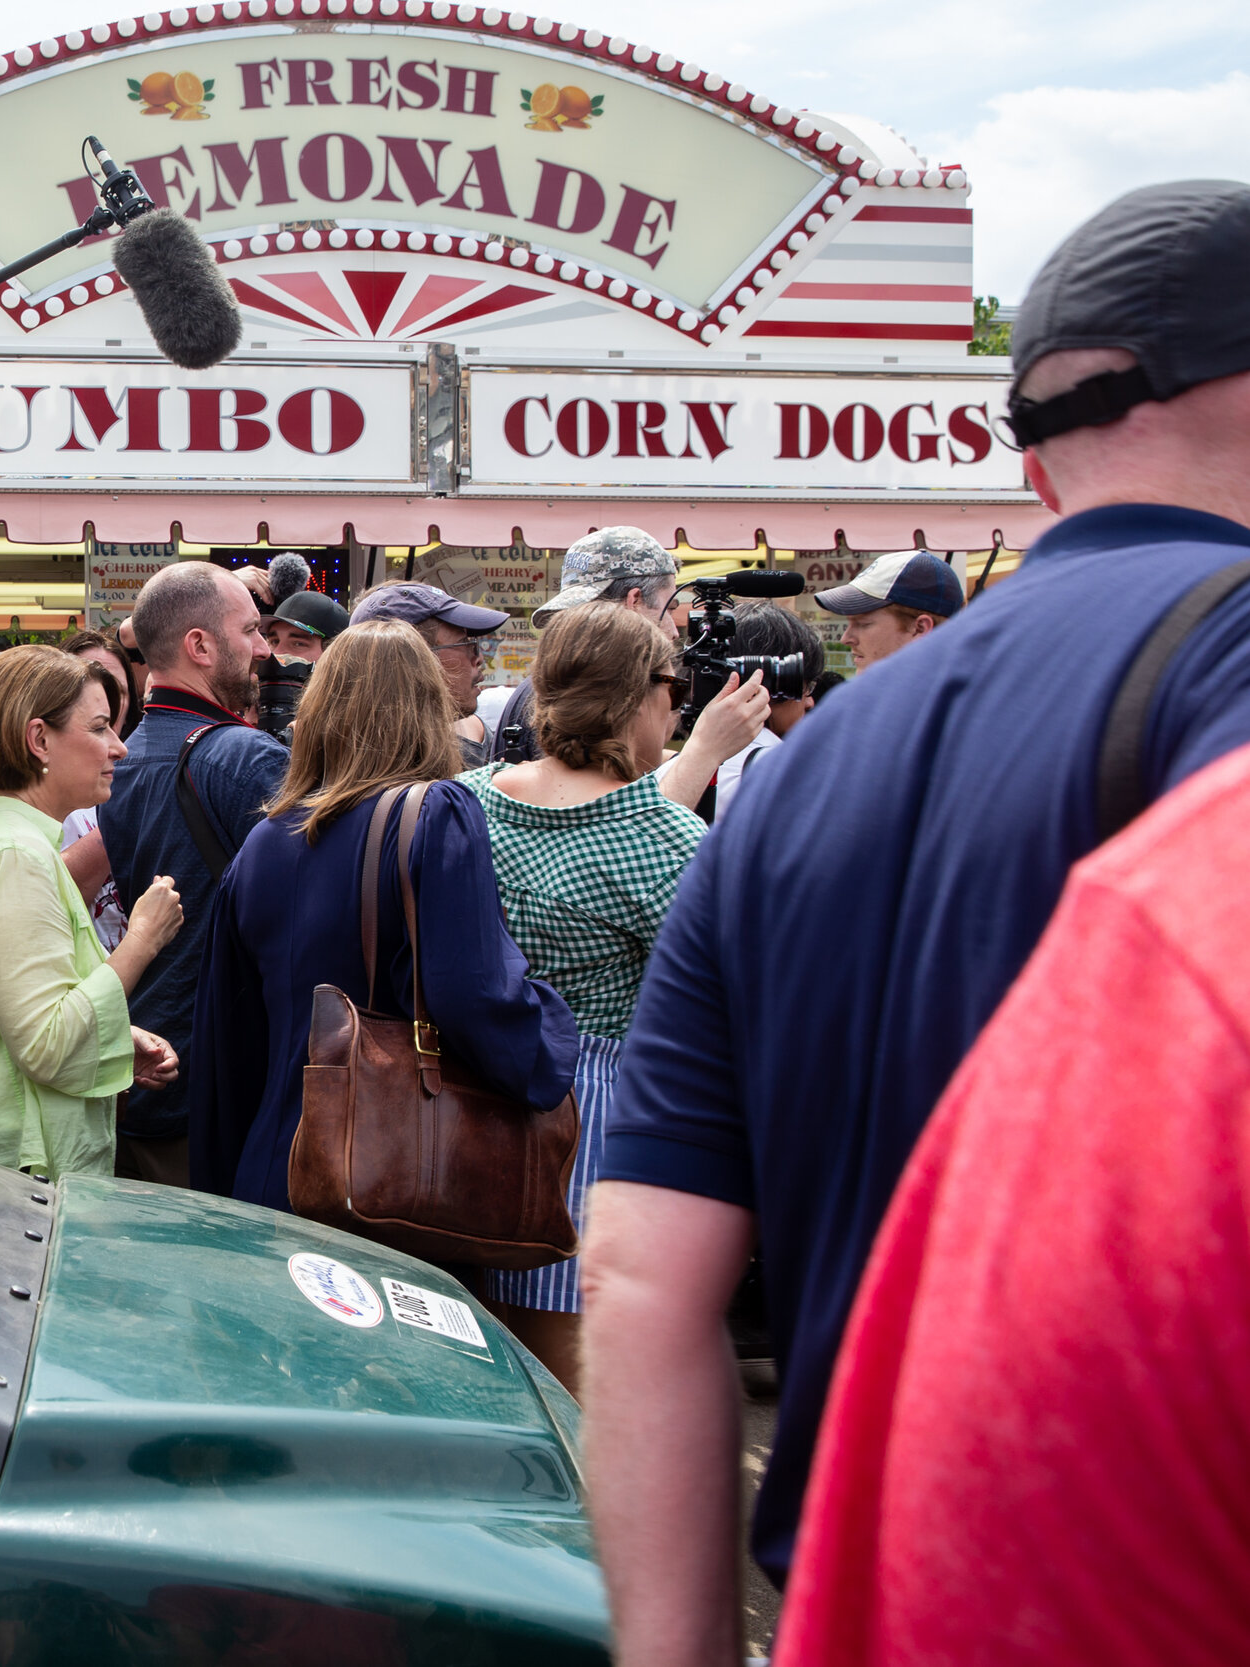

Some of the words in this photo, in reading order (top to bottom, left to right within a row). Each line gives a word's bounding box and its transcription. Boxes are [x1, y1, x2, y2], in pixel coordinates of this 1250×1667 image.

[236, 57, 501, 118] FRESH
[57, 133, 677, 271] LEMONADE
[504, 394, 738, 463] CORN
[773, 401, 992, 468] DOGS
[94, 542, 118, 556] ICE
[130, 542, 175, 557] COLD
[471, 547, 489, 561] CE
[500, 547, 543, 561] COLD
[481, 567, 532, 578] HERRY
[807, 563, 863, 581] ANY
[101, 578, 148, 589] LEMON
[93, 591, 125, 600] $4.00
